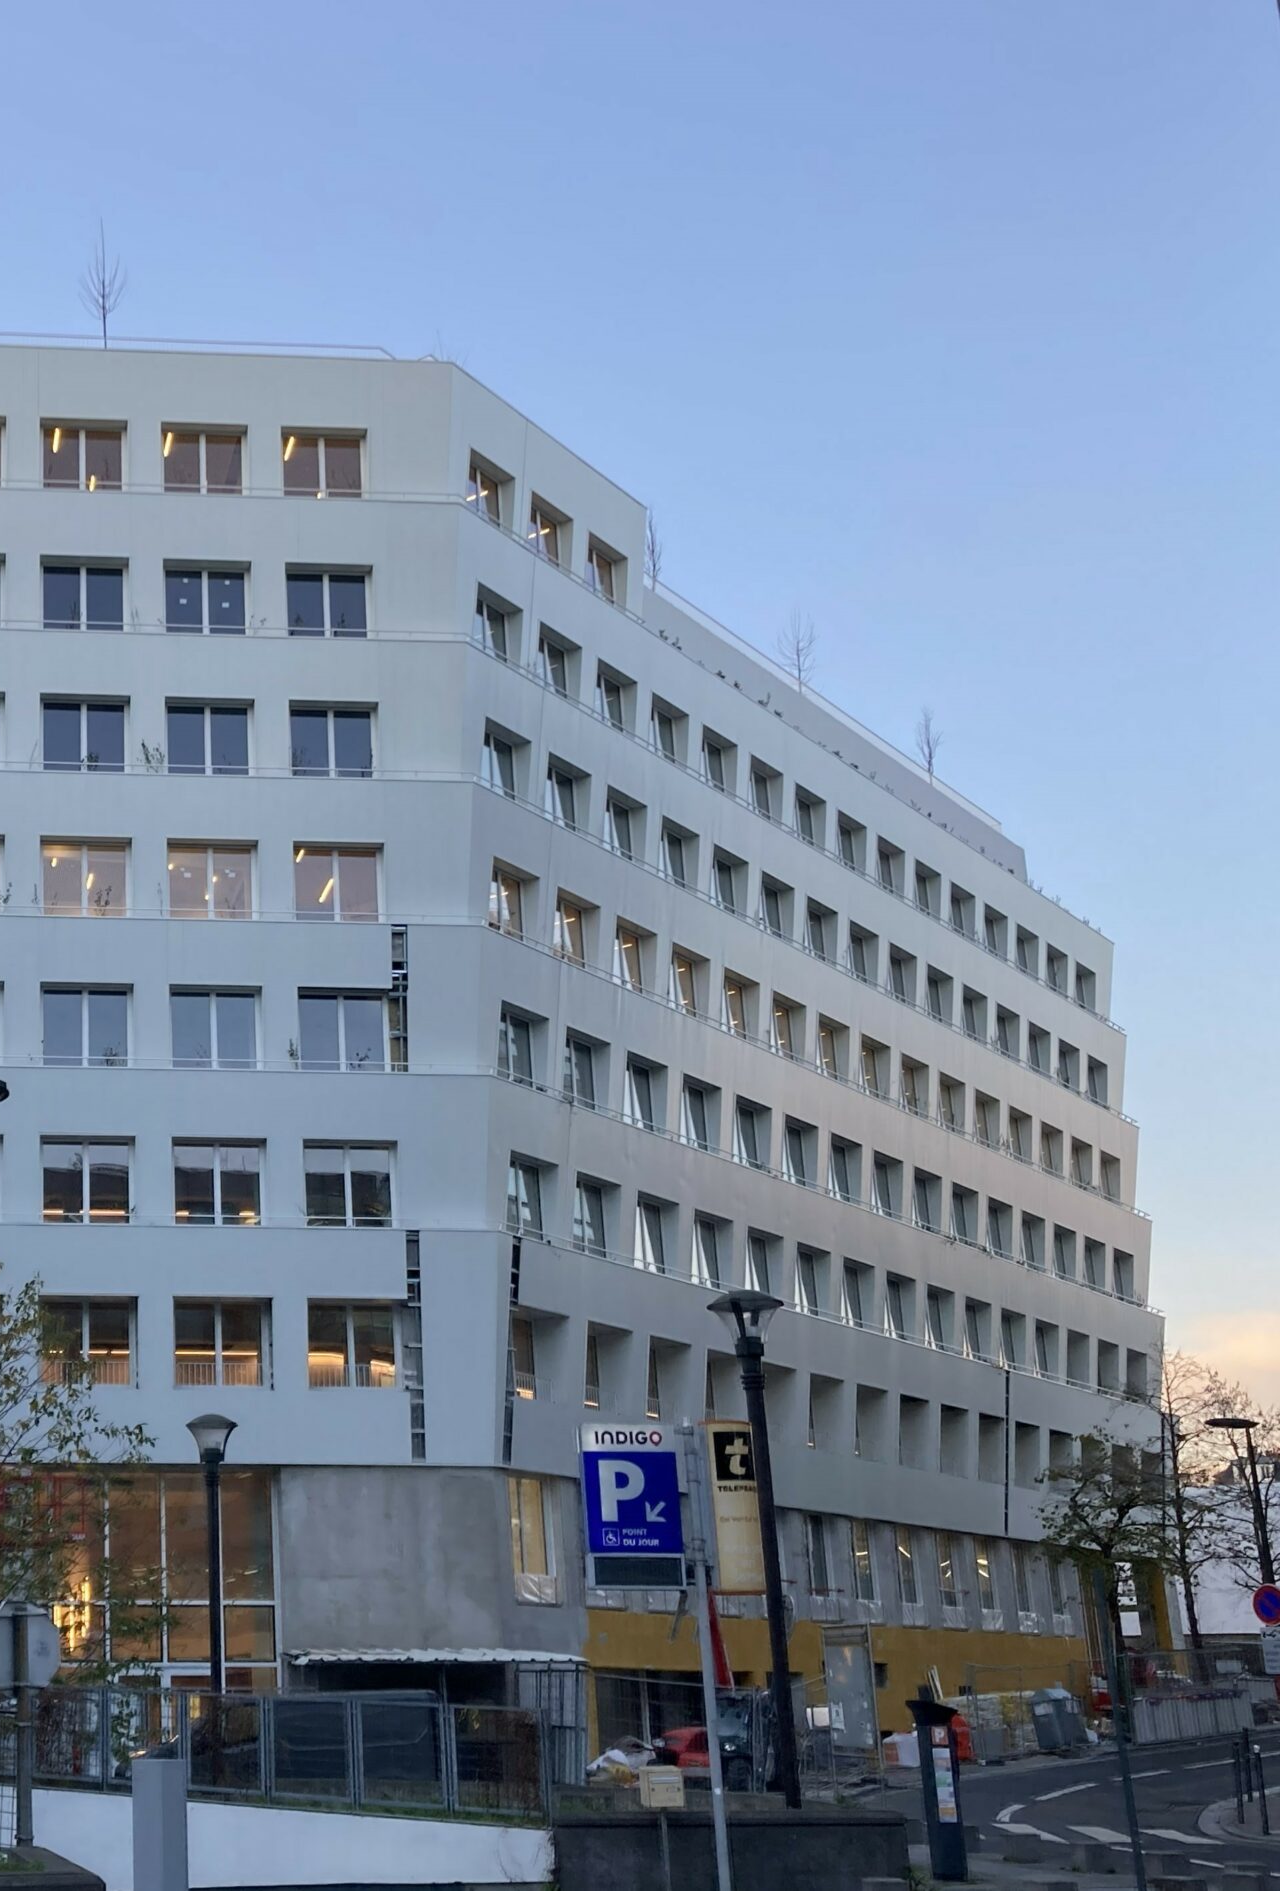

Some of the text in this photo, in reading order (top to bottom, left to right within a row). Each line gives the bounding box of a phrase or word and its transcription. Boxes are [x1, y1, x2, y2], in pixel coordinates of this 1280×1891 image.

[595, 1431, 662, 1446] INDIGO
[598, 1459, 645, 1522] P
[622, 1528, 647, 1536] POINT
[623, 1538, 660, 1547] DU JOUR
[934, 1728, 945, 1743] P
